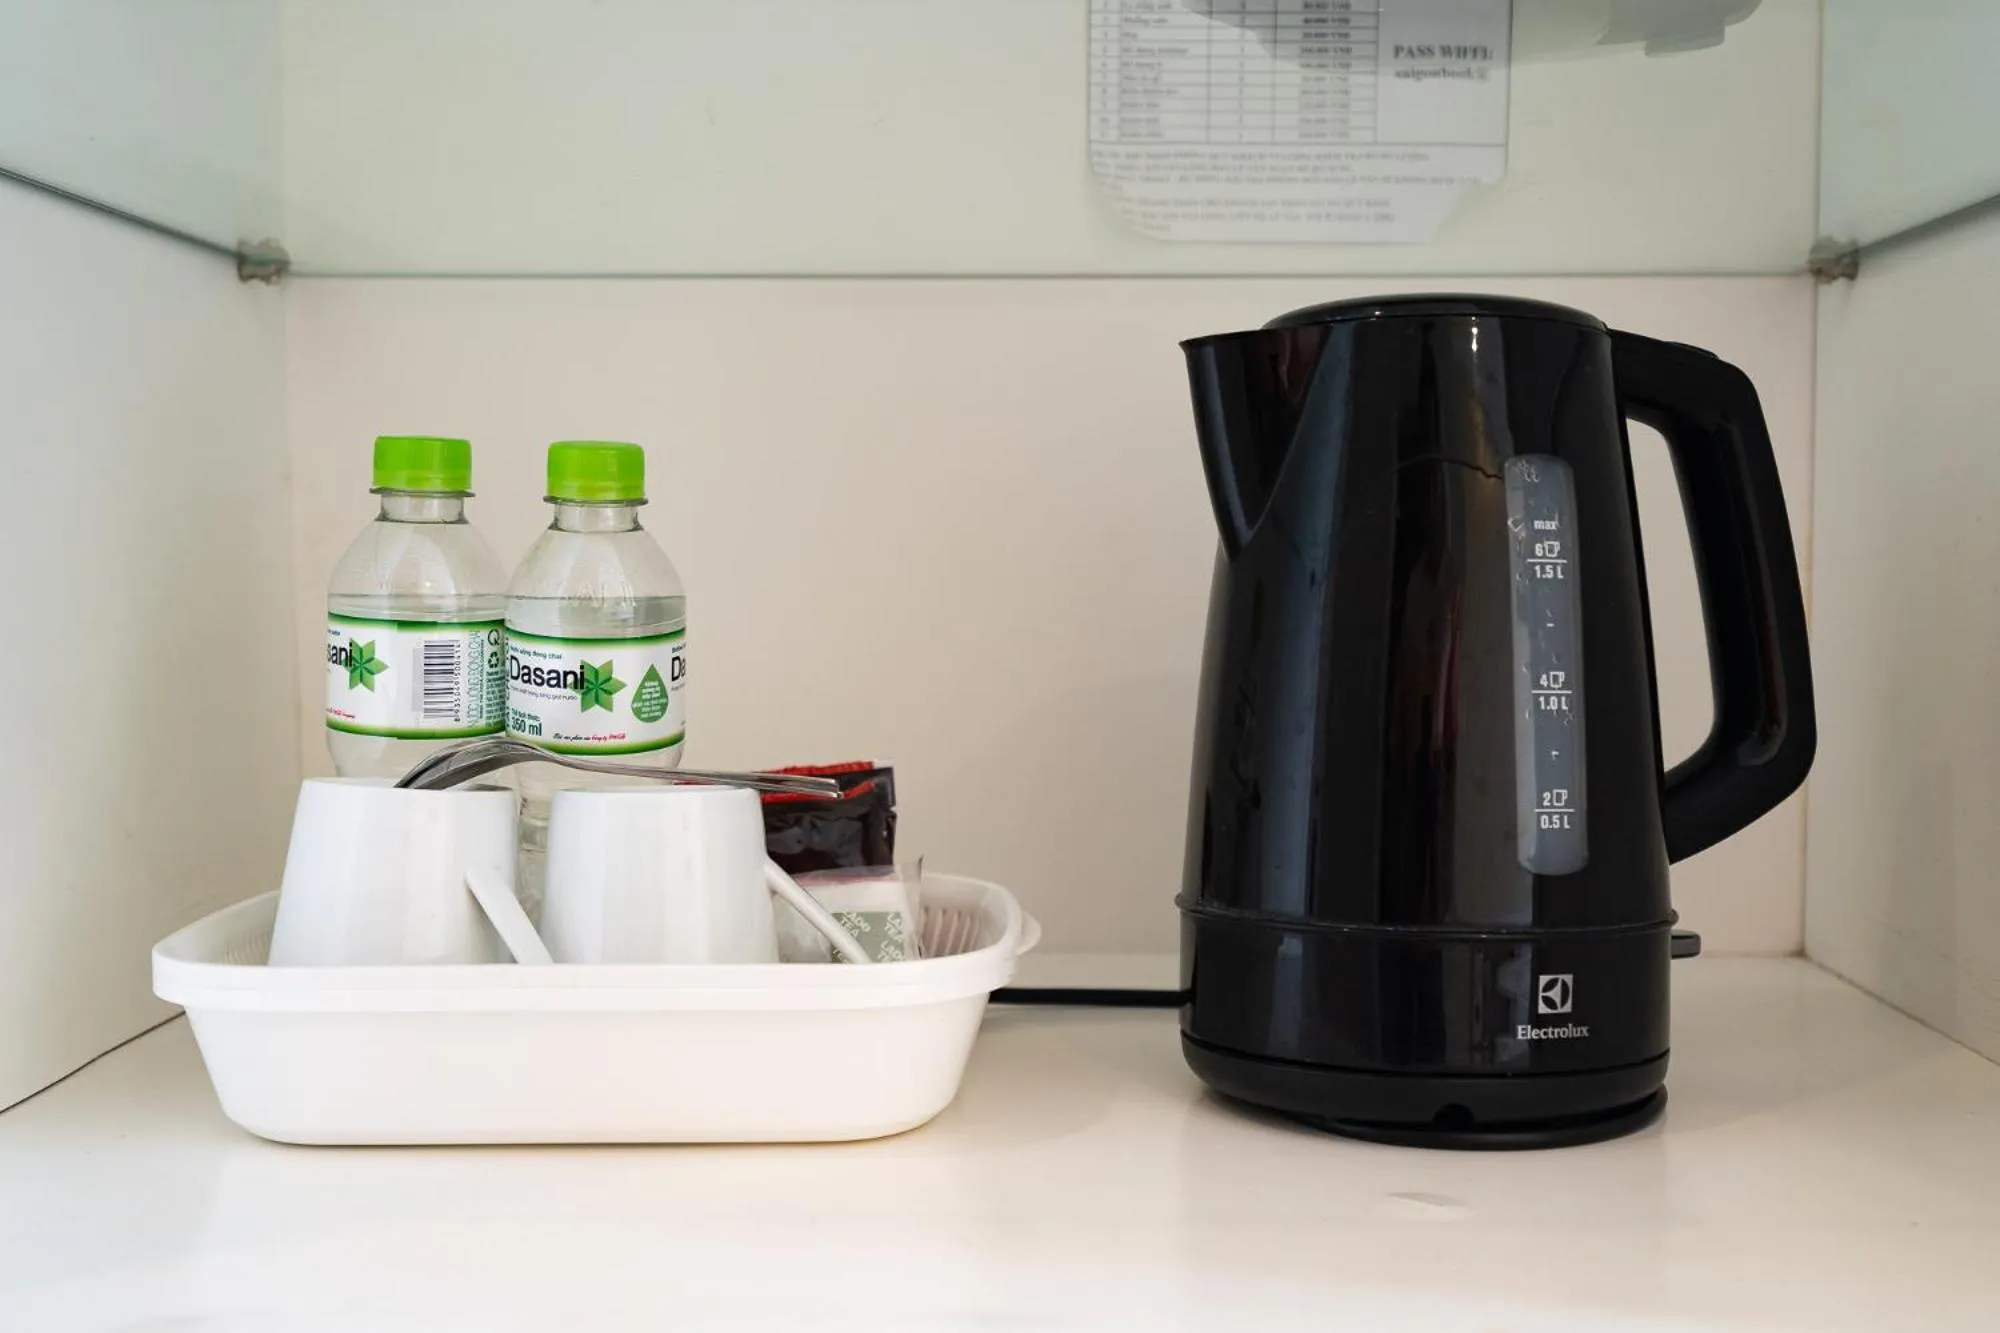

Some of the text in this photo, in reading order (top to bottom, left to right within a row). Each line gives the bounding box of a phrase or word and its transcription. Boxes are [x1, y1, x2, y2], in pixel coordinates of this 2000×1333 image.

[1393, 44, 1436, 60] PASS
[1533, 519, 1558, 531] max
[1535, 543, 1544, 557] 6
[1535, 564, 1564, 579] 1.5 L
[510, 655, 585, 690] Dasani
[1540, 673, 1548, 687] 4
[1539, 696, 1568, 710] 1.0 L
[528, 722, 542, 736] ml
[1543, 791, 1551, 806] 2
[1541, 814, 1570, 829] 0.5 L
[1516, 1023, 1590, 1040] Electrolux
